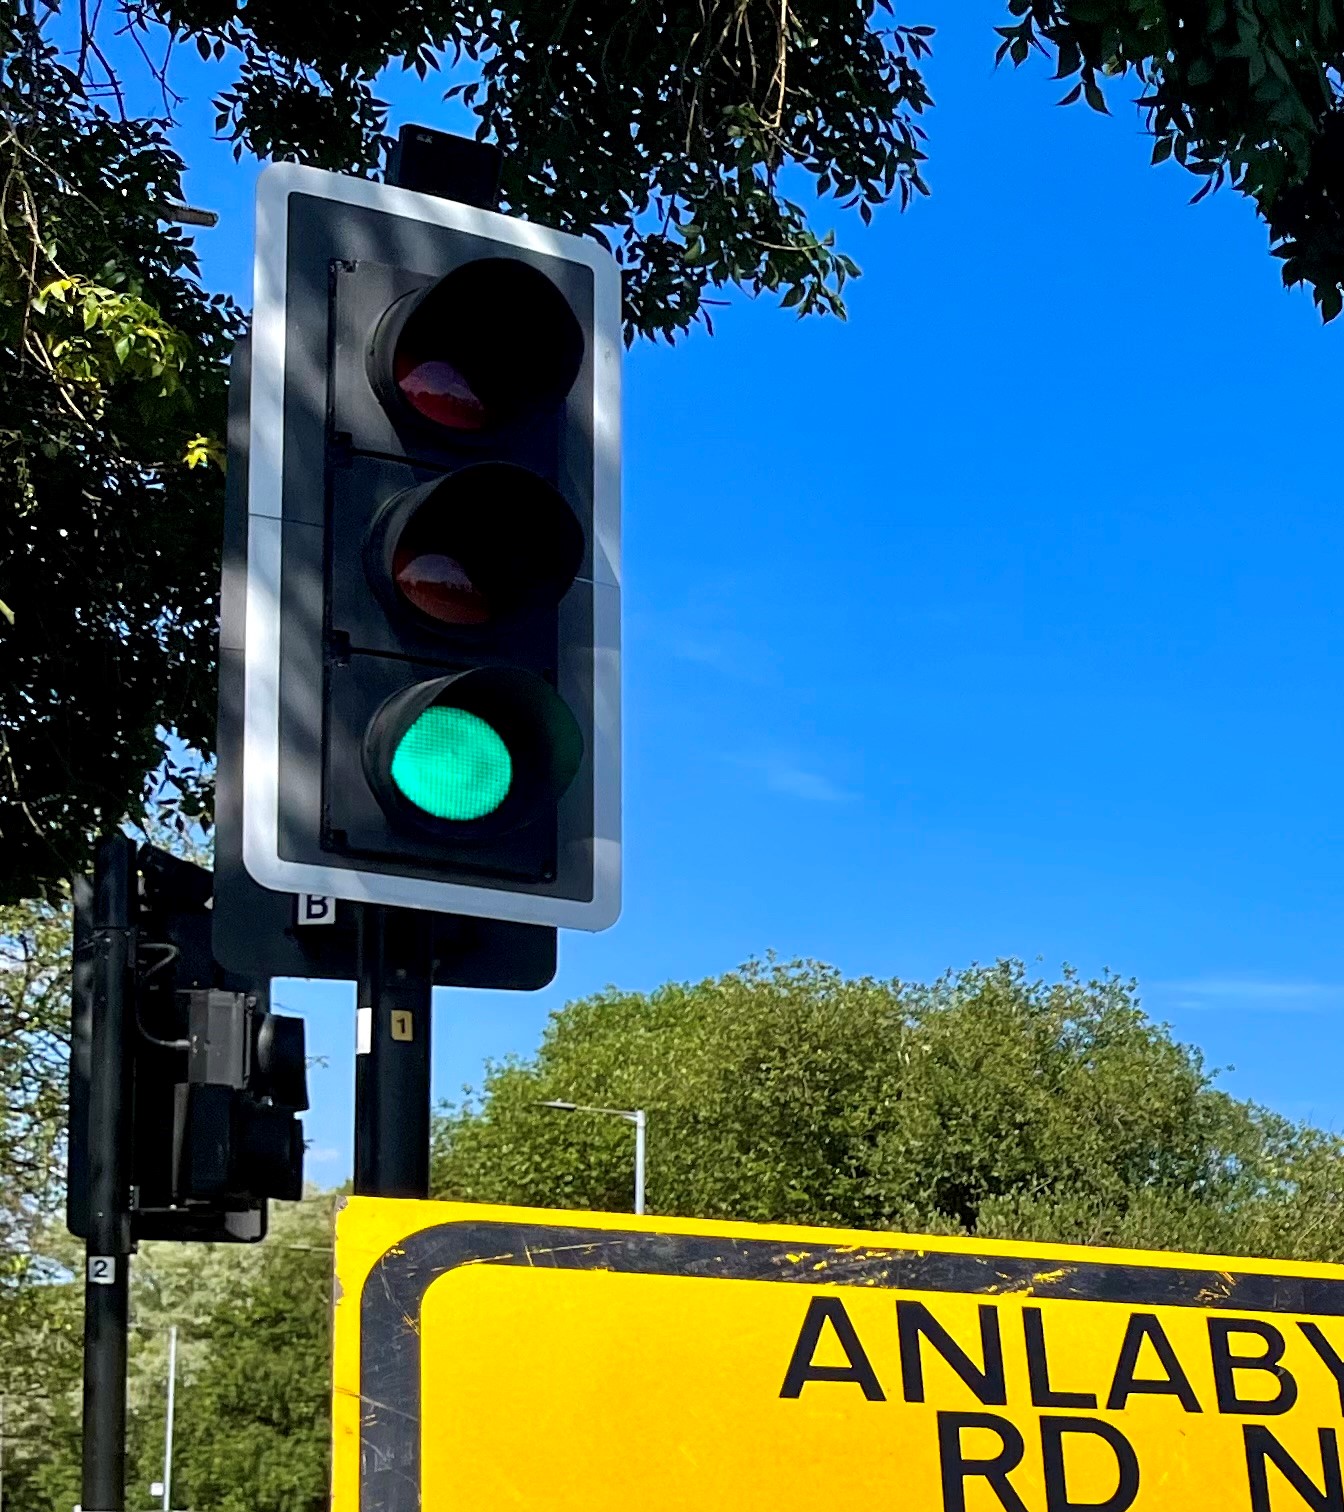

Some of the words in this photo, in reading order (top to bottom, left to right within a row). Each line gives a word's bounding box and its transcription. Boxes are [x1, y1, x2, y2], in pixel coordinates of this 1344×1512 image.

[306, 895, 328, 919] B
[396, 1017, 406, 1034] 1
[94, 1260, 108, 1278] 2
